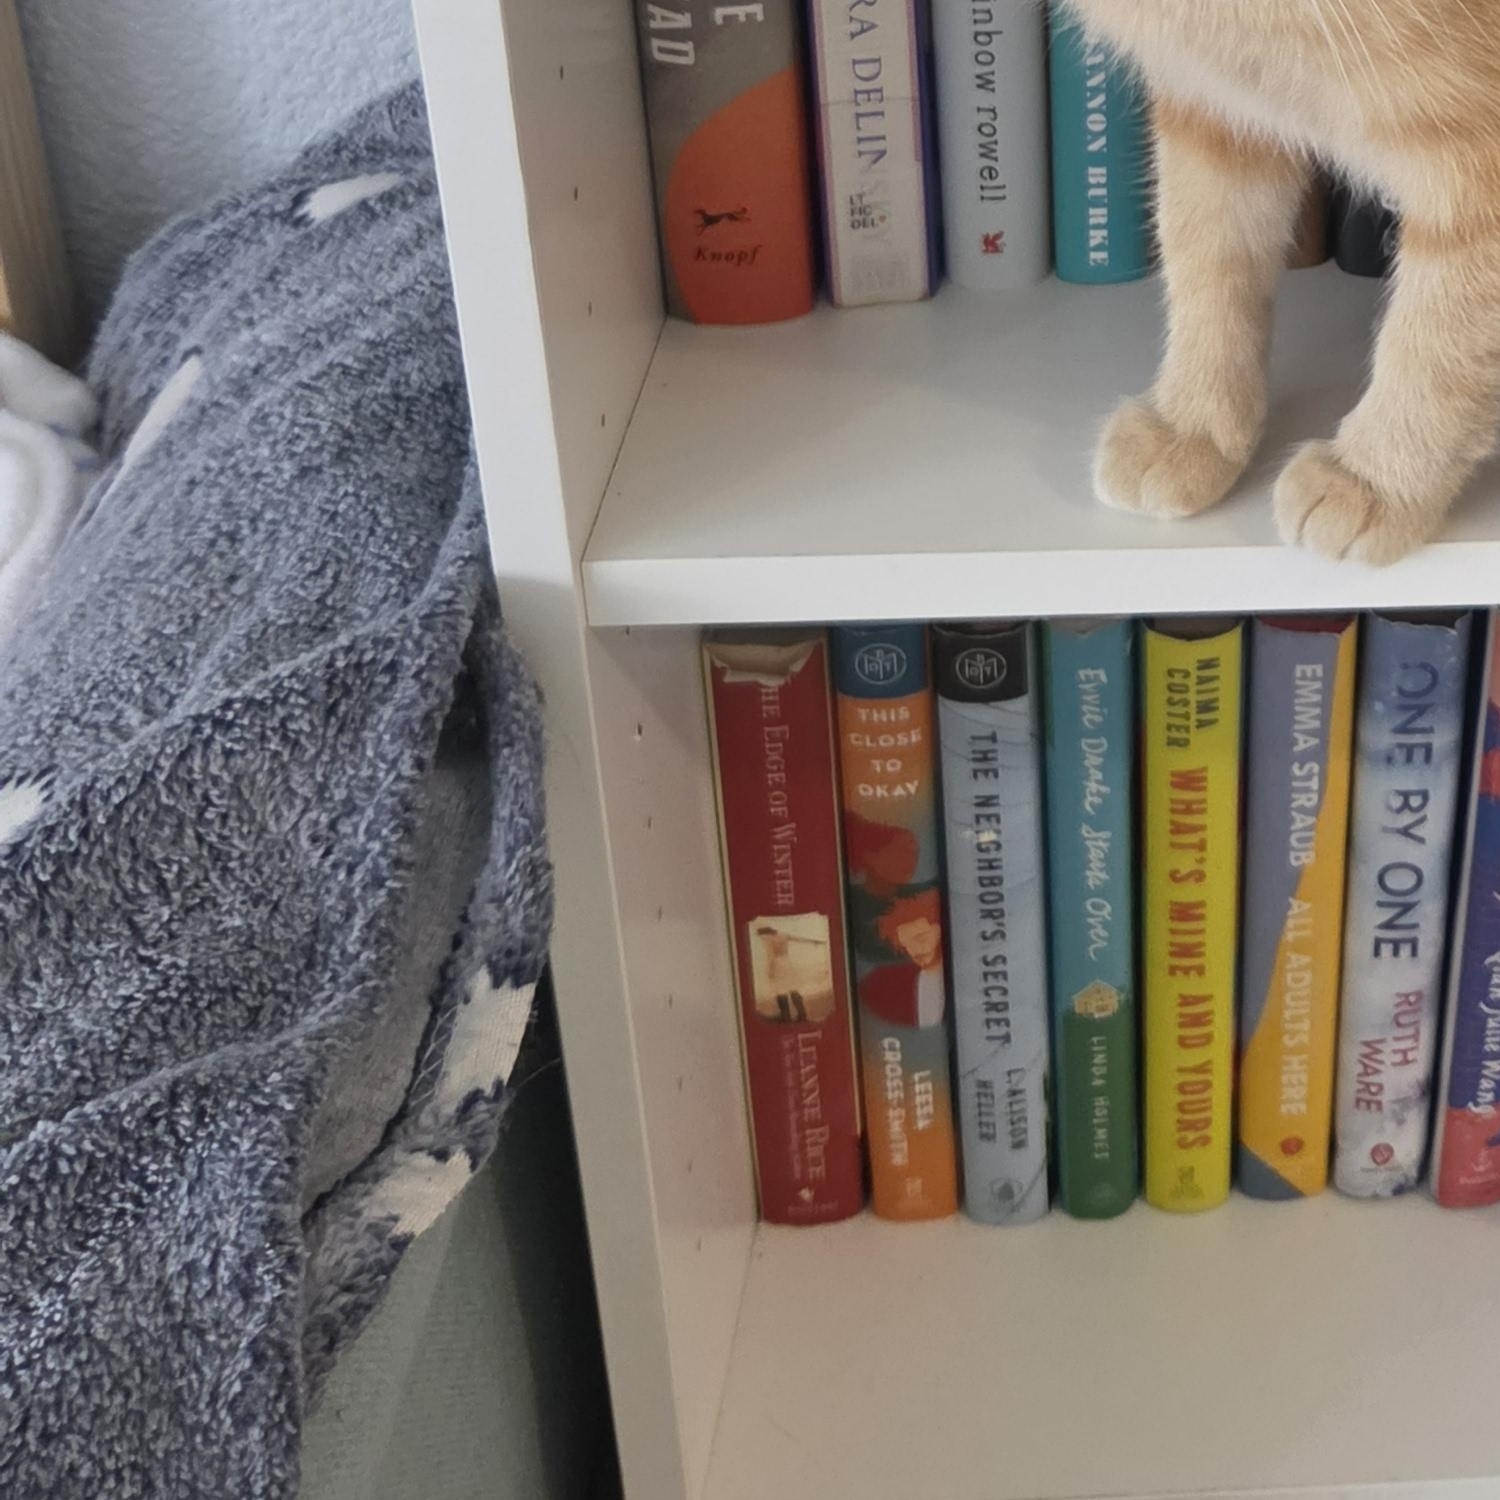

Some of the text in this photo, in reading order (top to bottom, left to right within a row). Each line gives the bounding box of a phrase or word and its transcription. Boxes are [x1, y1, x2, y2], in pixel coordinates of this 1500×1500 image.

[976, 106, 1007, 203] rowell
[695, 244, 763, 266] Knopf
[1087, 166, 1109, 267] BURKE
[857, 706, 910, 722] THIS
[1166, 667, 1190, 749] COSTER
[1195, 656, 1220, 730] NAIMA
[850, 728, 922, 747] CLOSE
[871, 758, 902, 773] TO
[968, 730, 999, 781] THE
[1081, 736, 1110, 816] Drake
[1289, 663, 1323, 867] EMMA STRAUB
[763, 724, 798, 907] EDGE OF WINTER
[857, 780, 920, 798] OKAY
[1373, 660, 1439, 959] ONE BY ONE
[1085, 896, 1113, 961] Over
[1167, 766, 1214, 1150] WHAT'S MINE AND YOURS
[981, 954, 1011, 1046] SECRET
[1279, 897, 1314, 1117] ALL ADULTS HERE
[1391, 989, 1424, 1067] RUTH
[1355, 1038, 1387, 1114] WARE
